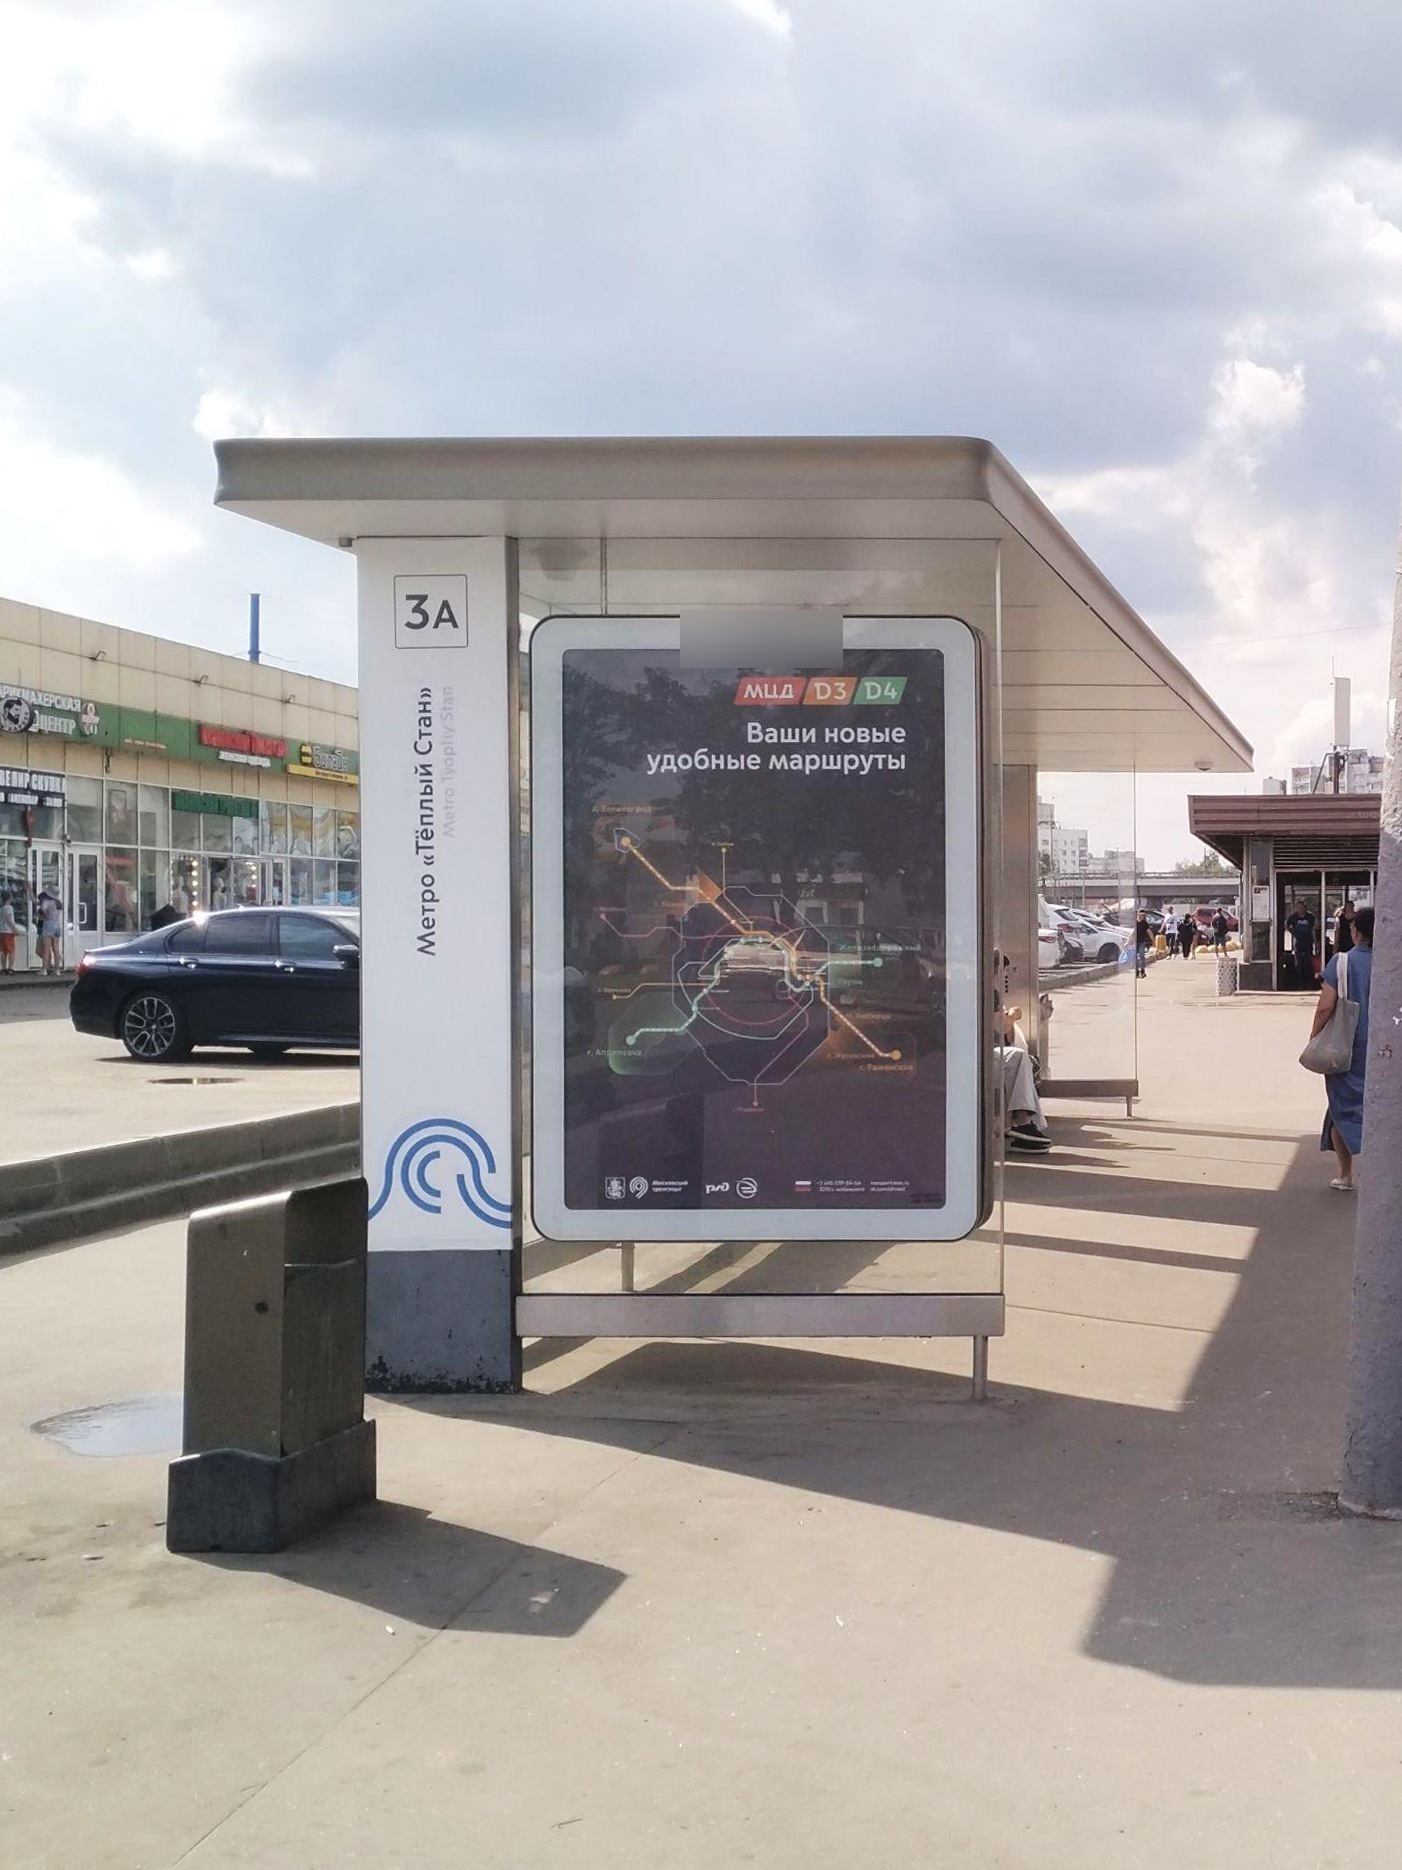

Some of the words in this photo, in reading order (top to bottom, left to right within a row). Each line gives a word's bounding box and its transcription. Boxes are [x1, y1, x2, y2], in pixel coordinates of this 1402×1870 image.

[404, 594, 459, 630] 3А
[440, 686, 454, 721] Stan
[743, 681, 795, 700] МЦД
[813, 681, 848, 700] D3
[864, 681, 899, 700] D4
[413, 686, 433, 756] Стан»
[747, 722, 817, 744] Ваши
[824, 727, 907, 744] новые
[646, 748, 762, 775] удобные
[769, 752, 907, 775] маршруты
[413, 763, 435, 866] «Тёплый
[442, 787, 456, 839] Metro
[416, 873, 440, 957] Метро
